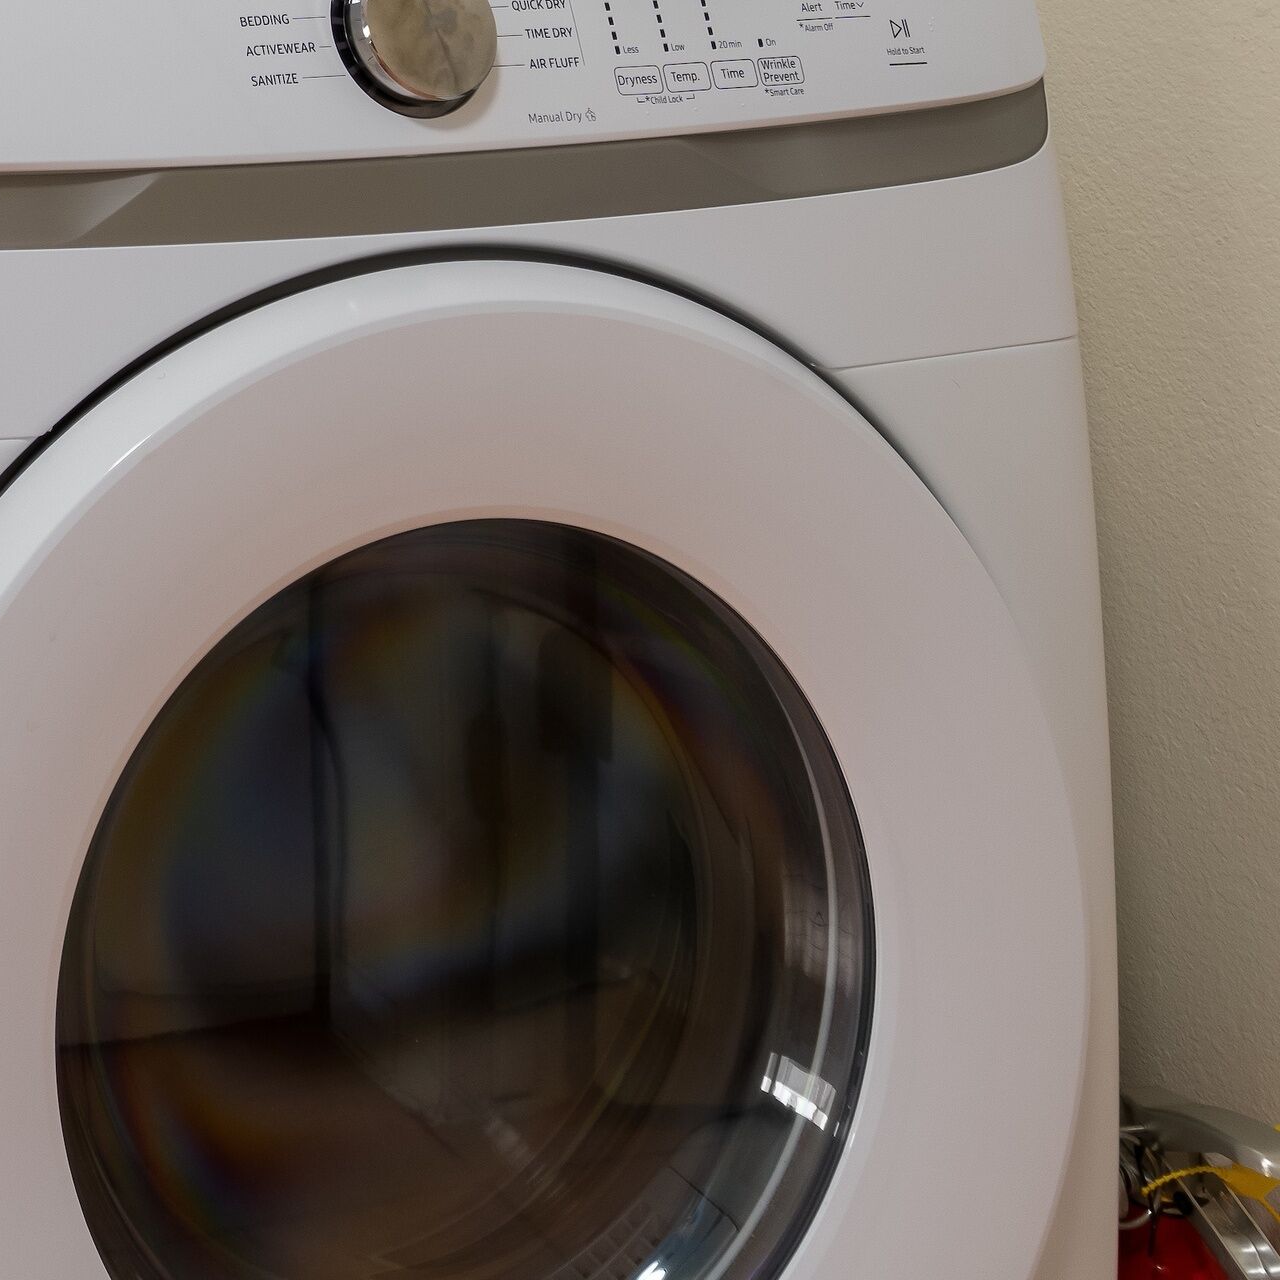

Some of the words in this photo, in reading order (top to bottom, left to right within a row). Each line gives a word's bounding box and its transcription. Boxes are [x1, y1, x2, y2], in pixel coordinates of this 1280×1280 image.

[511, 0, 543, 11] QUICK
[545, 0, 566, 10] DRY
[801, 3, 822, 12] Alert
[835, 1, 856, 10] Time
[240, 14, 290, 27] BEDDING
[525, 28, 551, 39] TIME
[552, 27, 573, 38] DRY
[671, 44, 685, 52] Low
[728, 40, 742, 48] min
[766, 39, 776, 47] On
[246, 42, 316, 56] ACTIVEWEAR
[623, 45, 639, 54] Less
[887, 48, 901, 56] Hold
[909, 46, 925, 55] Start
[529, 58, 547, 69] AIR
[549, 57, 580, 68] FLUFF
[761, 59, 796, 69] Wrinkle
[671, 71, 700, 83] Temp.
[721, 68, 745, 79] Time
[763, 72, 800, 83] Prevent
[251, 73, 299, 86] SANITIZE
[618, 74, 658, 87] Dryness
[792, 87, 805, 96] Care
[668, 95, 683, 104] Lock
[528, 112, 564, 124] Manual
[565, 111, 582, 123] Dry
